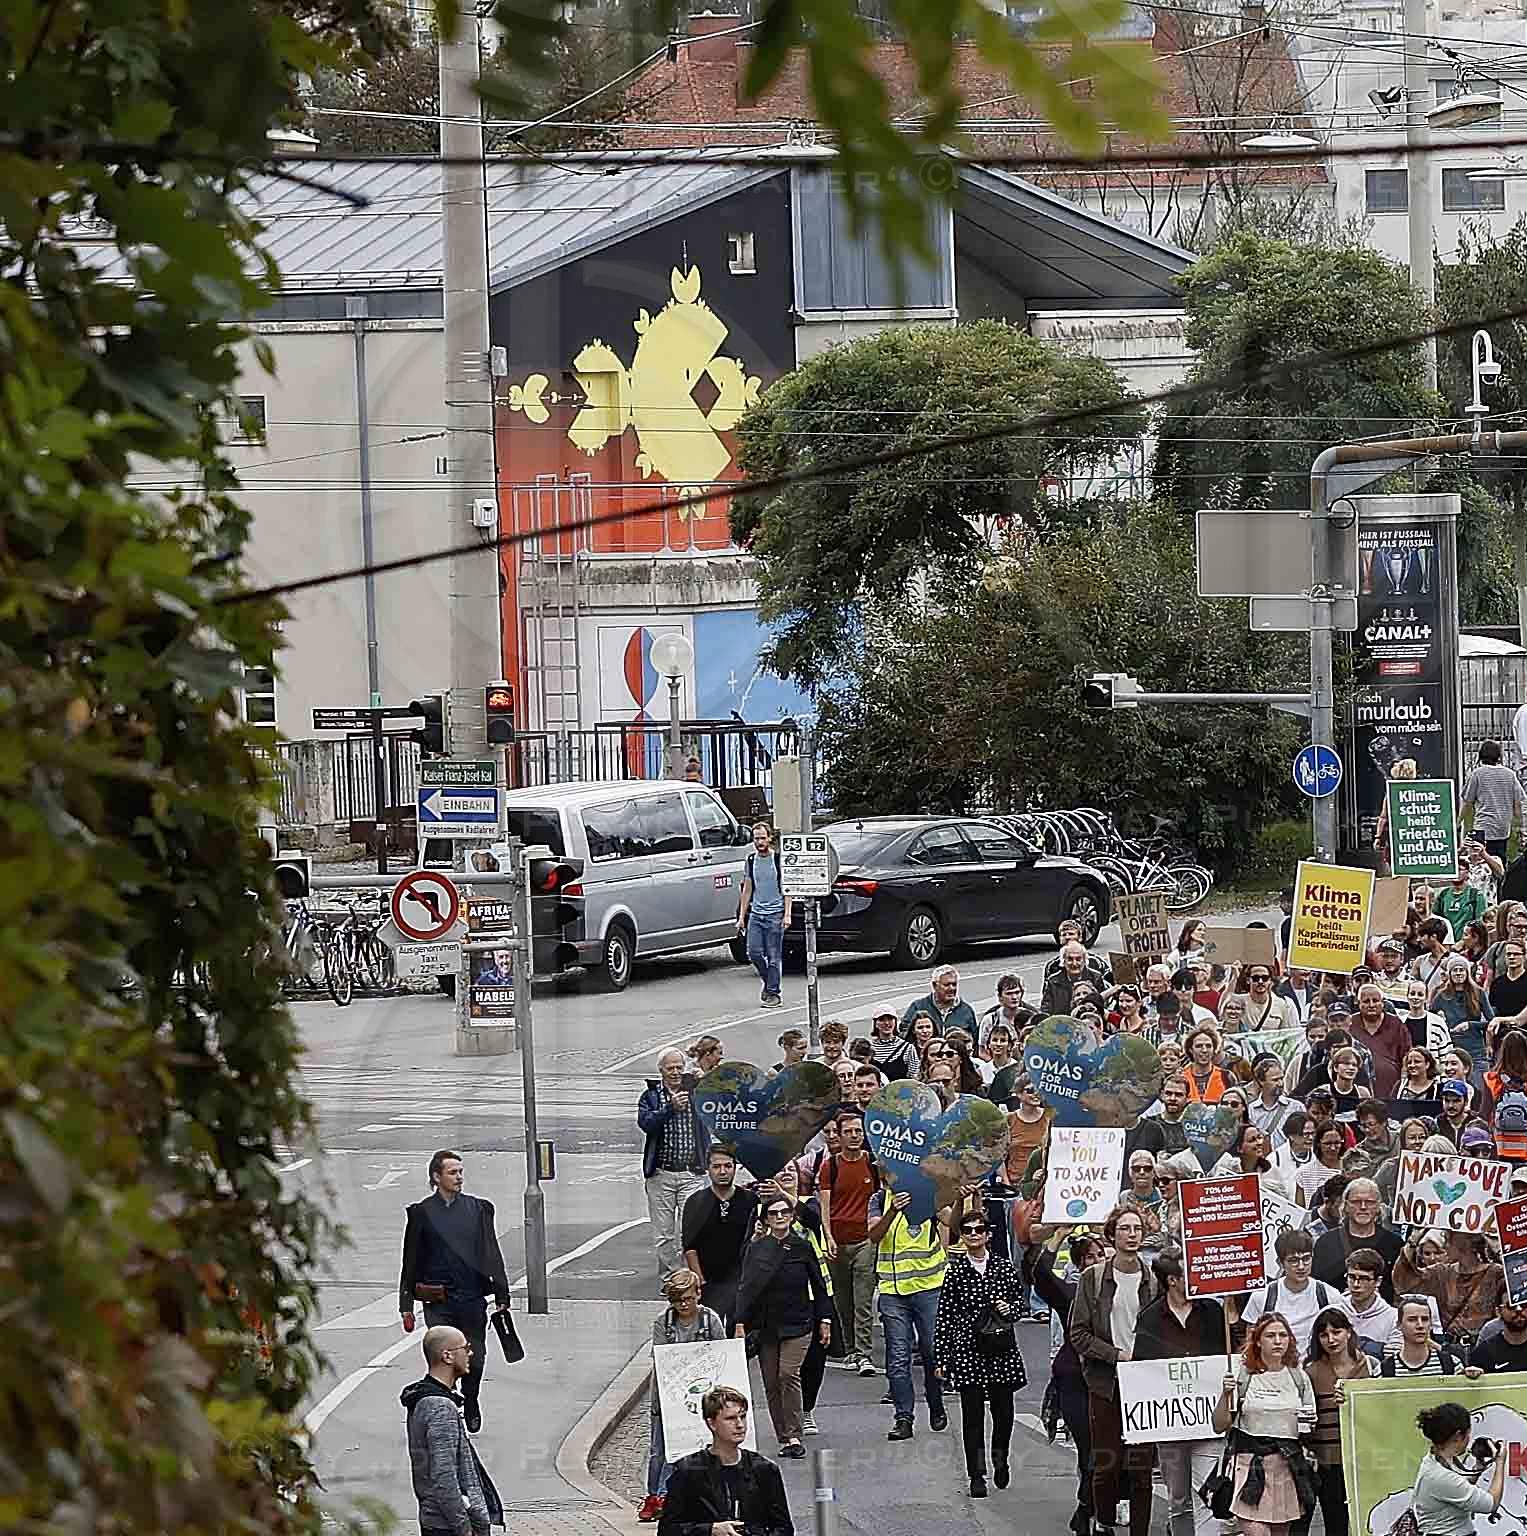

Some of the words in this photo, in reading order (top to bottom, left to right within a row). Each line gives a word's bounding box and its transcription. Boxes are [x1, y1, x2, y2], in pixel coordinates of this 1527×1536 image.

[1359, 531, 1378, 540] HIER
[1380, 531, 1392, 540] IST
[1394, 530, 1431, 539] FUSSBALL
[1380, 540, 1397, 548] ALS
[1399, 538, 1434, 547] FUSSBALL
[1364, 624, 1433, 641] CANAL+
[1357, 697, 1432, 720] murlaub
[1375, 725, 1397, 733] vom
[1398, 721, 1426, 732] müde
[1398, 790, 1441, 803] Klima-
[443, 800, 490, 811] EINBAHN
[1399, 803, 1441, 815] schutz
[1407, 815, 1435, 826] heißt
[1398, 828, 1446, 840] Frieden
[1399, 840, 1423, 852] und
[1426, 841, 1449, 852] Ab-
[1398, 852, 1452, 866] rüstung!
[1304, 884, 1361, 905] Klima
[1118, 895, 1160, 919] PLANET
[1301, 903, 1362, 921] retten
[1129, 915, 1158, 930] OVER
[1316, 920, 1342, 932] heißt
[1297, 929, 1360, 941] Kapitalismus
[1125, 930, 1169, 954] PROFIT
[1297, 938, 1359, 952] überwinden!
[399, 944, 460, 955] Ausgenommen
[420, 954, 438, 963] Taxi
[1029, 1054, 1084, 1081] OMAS
[1040, 1072, 1061, 1085] FOR
[1038, 1081, 1080, 1100] FUTURE
[701, 1100, 758, 1114] OMAS
[715, 1113, 737, 1121] FOR
[715, 1121, 757, 1130] FUTURE
[1185, 1121, 1208, 1133] OMAS
[869, 1119, 926, 1147] OMAS
[1058, 1130, 1080, 1144] WE
[880, 1138, 902, 1150] FOR
[879, 1147, 921, 1165] FUTURE
[1071, 1146, 1096, 1161] YOU
[1054, 1168, 1071, 1180] TO
[1075, 1167, 1108, 1182] SAVE
[1458, 1158, 1508, 1198] LOVE
[1060, 1187, 1101, 1202] OURS
[1221, 1184, 1235, 1192] der
[1199, 1193, 1242, 1204] Emissionen
[1188, 1204, 1222, 1215] weltweit
[1223, 1200, 1255, 1211] kommen
[1394, 1191, 1441, 1226] NOT
[1448, 1199, 1499, 1232] CO2
[1187, 1214, 1203, 1223] von
[1203, 1213, 1217, 1222] 100
[1217, 1209, 1257, 1220] Konzernen
[1242, 1220, 1262, 1232] SPÖ
[1204, 1245, 1219, 1254] Wir
[1220, 1244, 1244, 1253] wollen
[1200, 1272, 1213, 1280] der
[1214, 1268, 1252, 1279] Wirtschaft
[1245, 1276, 1265, 1289] SPÖ
[1168, 1359, 1205, 1381] EAT
[1176, 1383, 1193, 1394] THE
